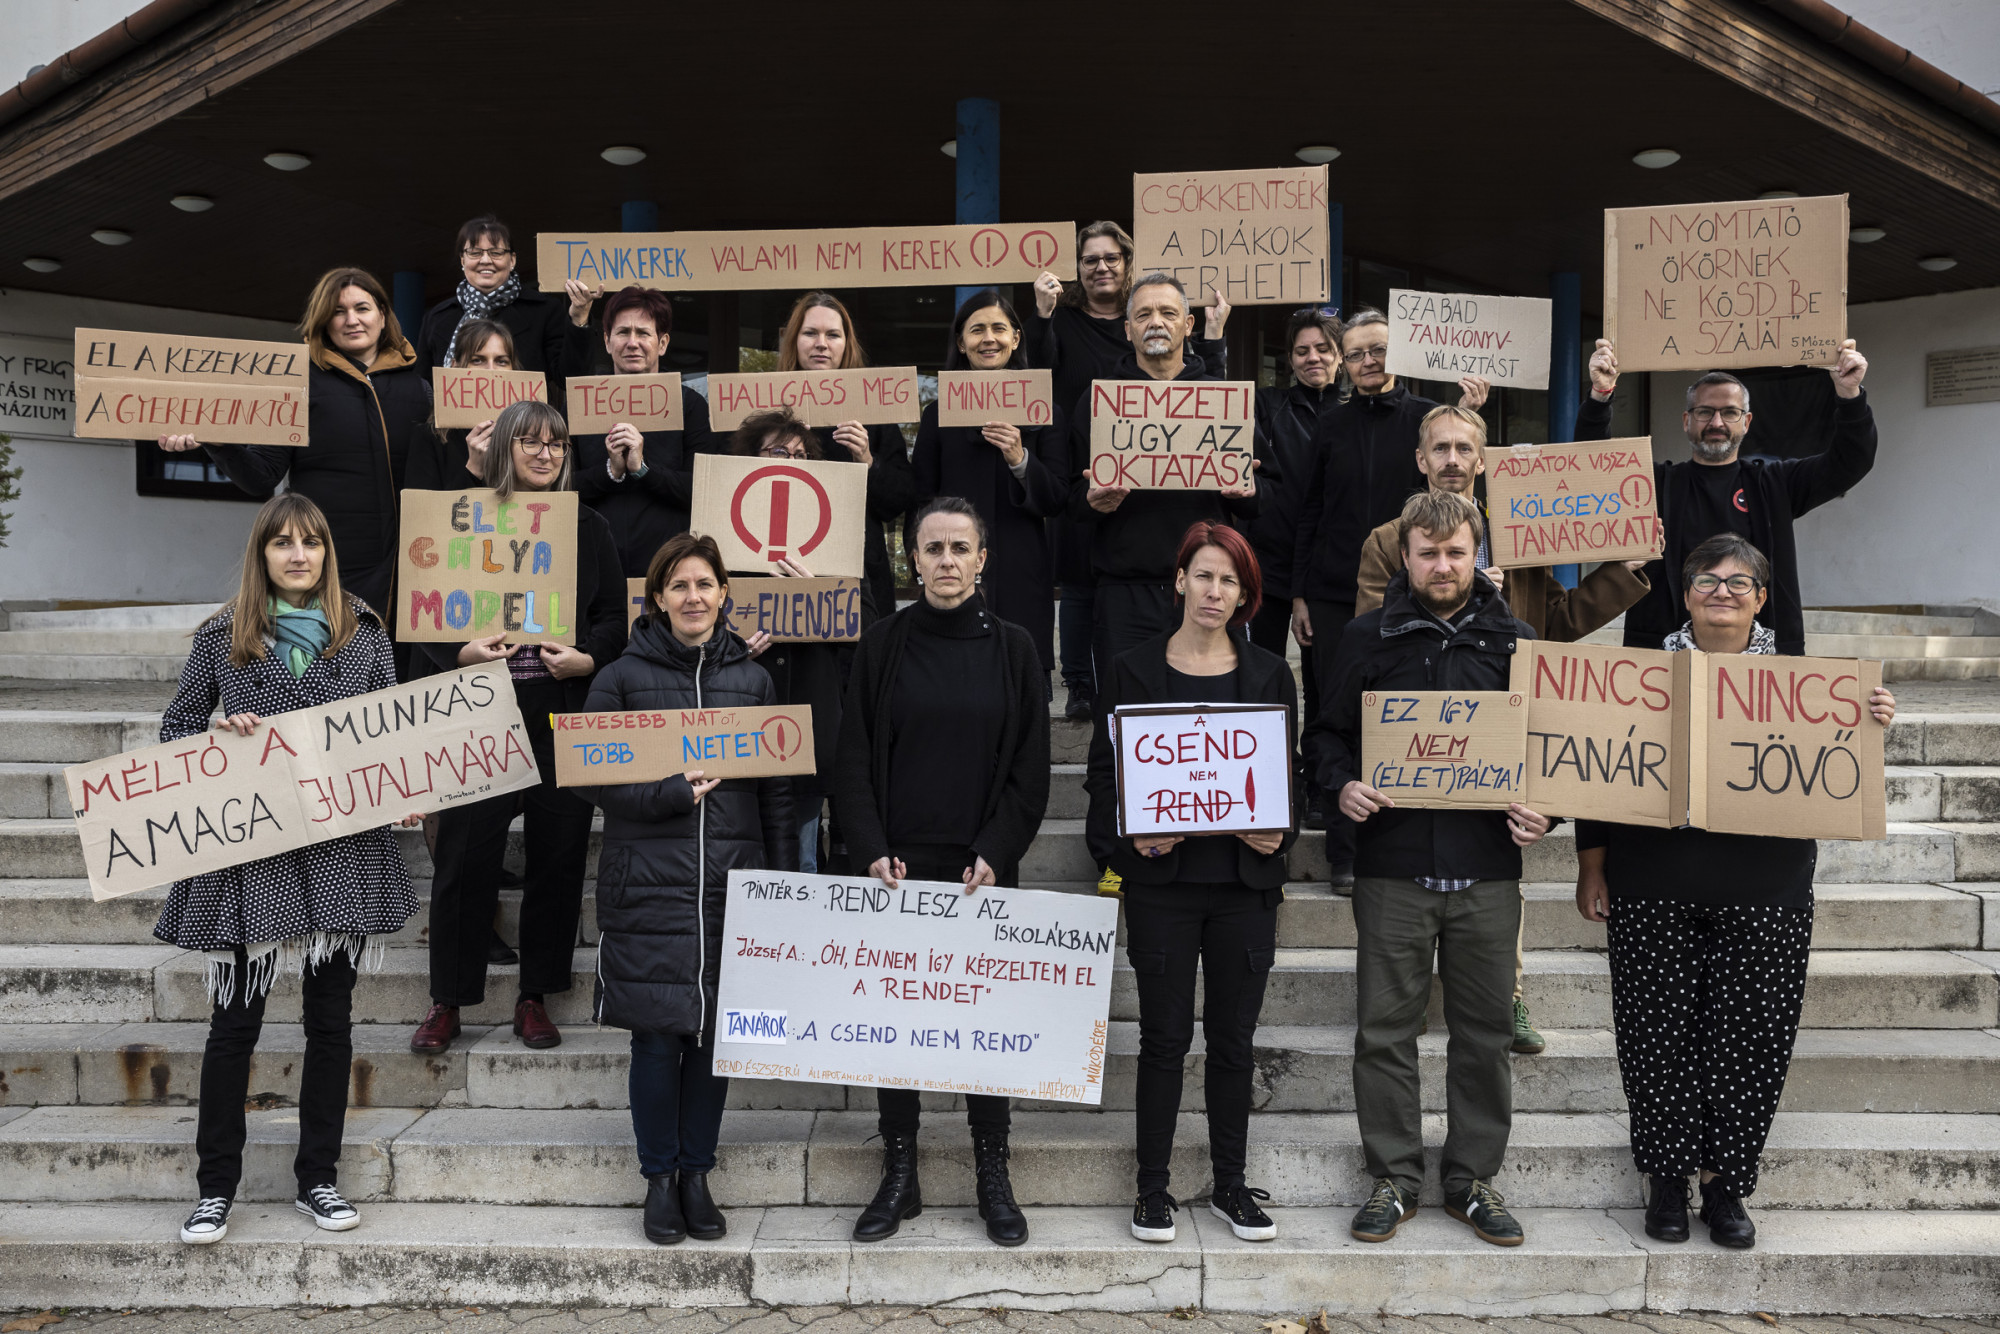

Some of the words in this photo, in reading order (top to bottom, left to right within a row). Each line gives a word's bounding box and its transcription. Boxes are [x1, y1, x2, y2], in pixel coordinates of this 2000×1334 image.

[1141, 172, 1326, 214] CSÖKKENTSÉK
[1161, 231, 1183, 256] A
[1202, 219, 1313, 257] DIÁKOK
[556, 241, 693, 280] TANKEREK,
[711, 244, 797, 273] VALAMI
[816, 241, 861, 271] NEM
[883, 240, 961, 272] KEREK
[1397, 294, 1477, 323] SZABAD
[1645, 288, 1676, 320] NE
[1699, 281, 1777, 317] KÖSD
[1788, 279, 1821, 314] BE
[1409, 323, 1512, 350] TANKÖNYV-
[1661, 335, 1680, 355] A
[1791, 337, 1799, 347] 5
[1802, 336, 1836, 347] Mózes
[24, 357, 75, 379] FRIG
[87, 342, 126, 368] EL
[134, 345, 156, 372] A
[165, 347, 302, 376] KEZEKKEL
[1425, 349, 1519, 378] VÁLASZTÁST
[442, 371, 544, 409] KÉRÜNK
[574, 379, 670, 418] TÉGED,
[718, 378, 846, 412] HALLGASS
[863, 377, 909, 405] MEG
[947, 380, 1032, 410] MINKET
[1093, 384, 1248, 420] NEMZETI
[85, 392, 109, 423] A
[116, 392, 304, 428] GYEREKEINKTŐL
[1112, 419, 1182, 452] ÜGY
[1196, 425, 1243, 452] AZ
[1092, 449, 1253, 488] OKTATÁS?
[1493, 450, 1581, 478] ADJÁTOK
[1589, 451, 1641, 474] VISSZA
[1556, 479, 1569, 491] A
[451, 495, 551, 535] ÉLET
[1511, 492, 1621, 519] KÖLCSEYS
[1504, 510, 1658, 558] TANÁROKAT!
[408, 535, 552, 575] GÁLYA
[410, 589, 569, 636] MODELL
[1535, 654, 1670, 711] NINCS
[1717, 666, 1861, 727] NINCS
[260, 727, 298, 766] A
[325, 674, 494, 751] MUNKÁS
[557, 713, 666, 730] KEVESEBB
[1194, 716, 1206, 727] A
[1380, 698, 1420, 724] EZ
[1439, 695, 1480, 724] ÍGY
[573, 742, 634, 766] TÖBB
[682, 731, 765, 763] NETET
[1135, 729, 1257, 765] CSEND
[1407, 733, 1470, 758] NEM
[1528, 724, 1668, 791] TANÁR
[1189, 771, 1217, 781] NEM
[1726, 729, 1860, 799] JÖVŐ
[107, 828, 144, 878] A
[146, 793, 282, 866] MAGA
[900, 890, 960, 918] LESZ
[977, 898, 1009, 920] AZ
[928, 948, 953, 973] ÍGY
[965, 952, 1066, 986] KÉPZELTEM
[1075, 967, 1096, 986] EL
[853, 979, 866, 995] A
[831, 1024, 897, 1043] CSEND
[911, 1029, 960, 1049] NEM
[1039, 1078, 1086, 1102] HATÉKONY
